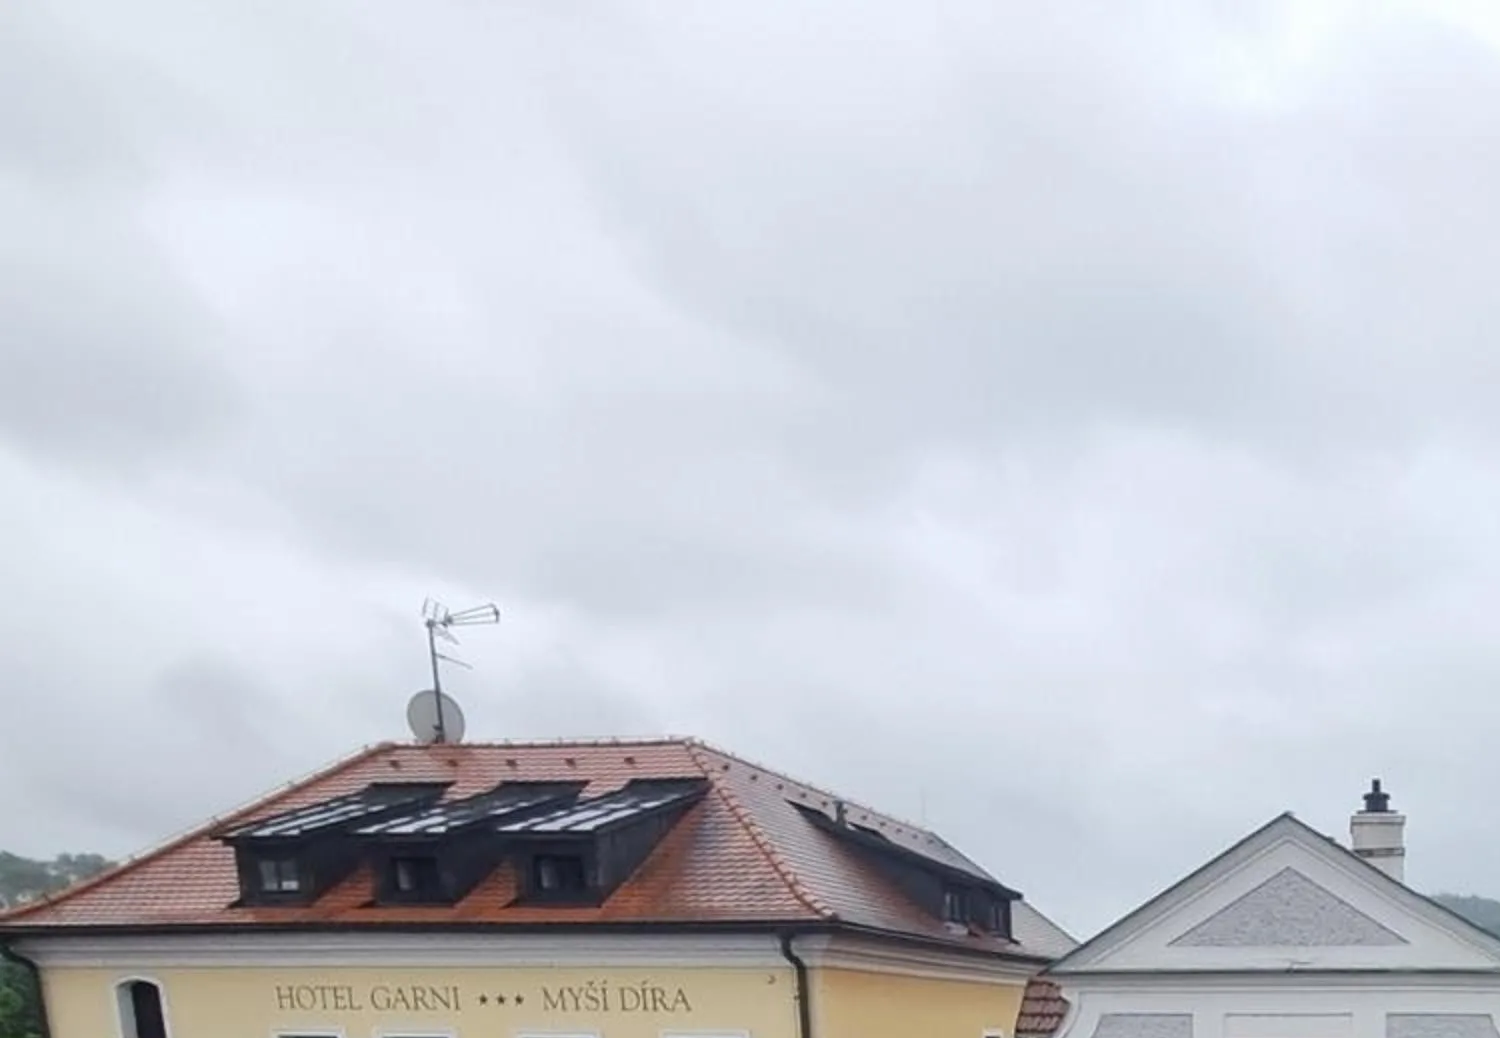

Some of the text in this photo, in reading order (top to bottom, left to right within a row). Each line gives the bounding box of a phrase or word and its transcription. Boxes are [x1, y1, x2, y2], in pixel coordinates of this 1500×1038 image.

[275, 980, 692, 1012] HOTEL GARNI MYŠÍ DÍRA
